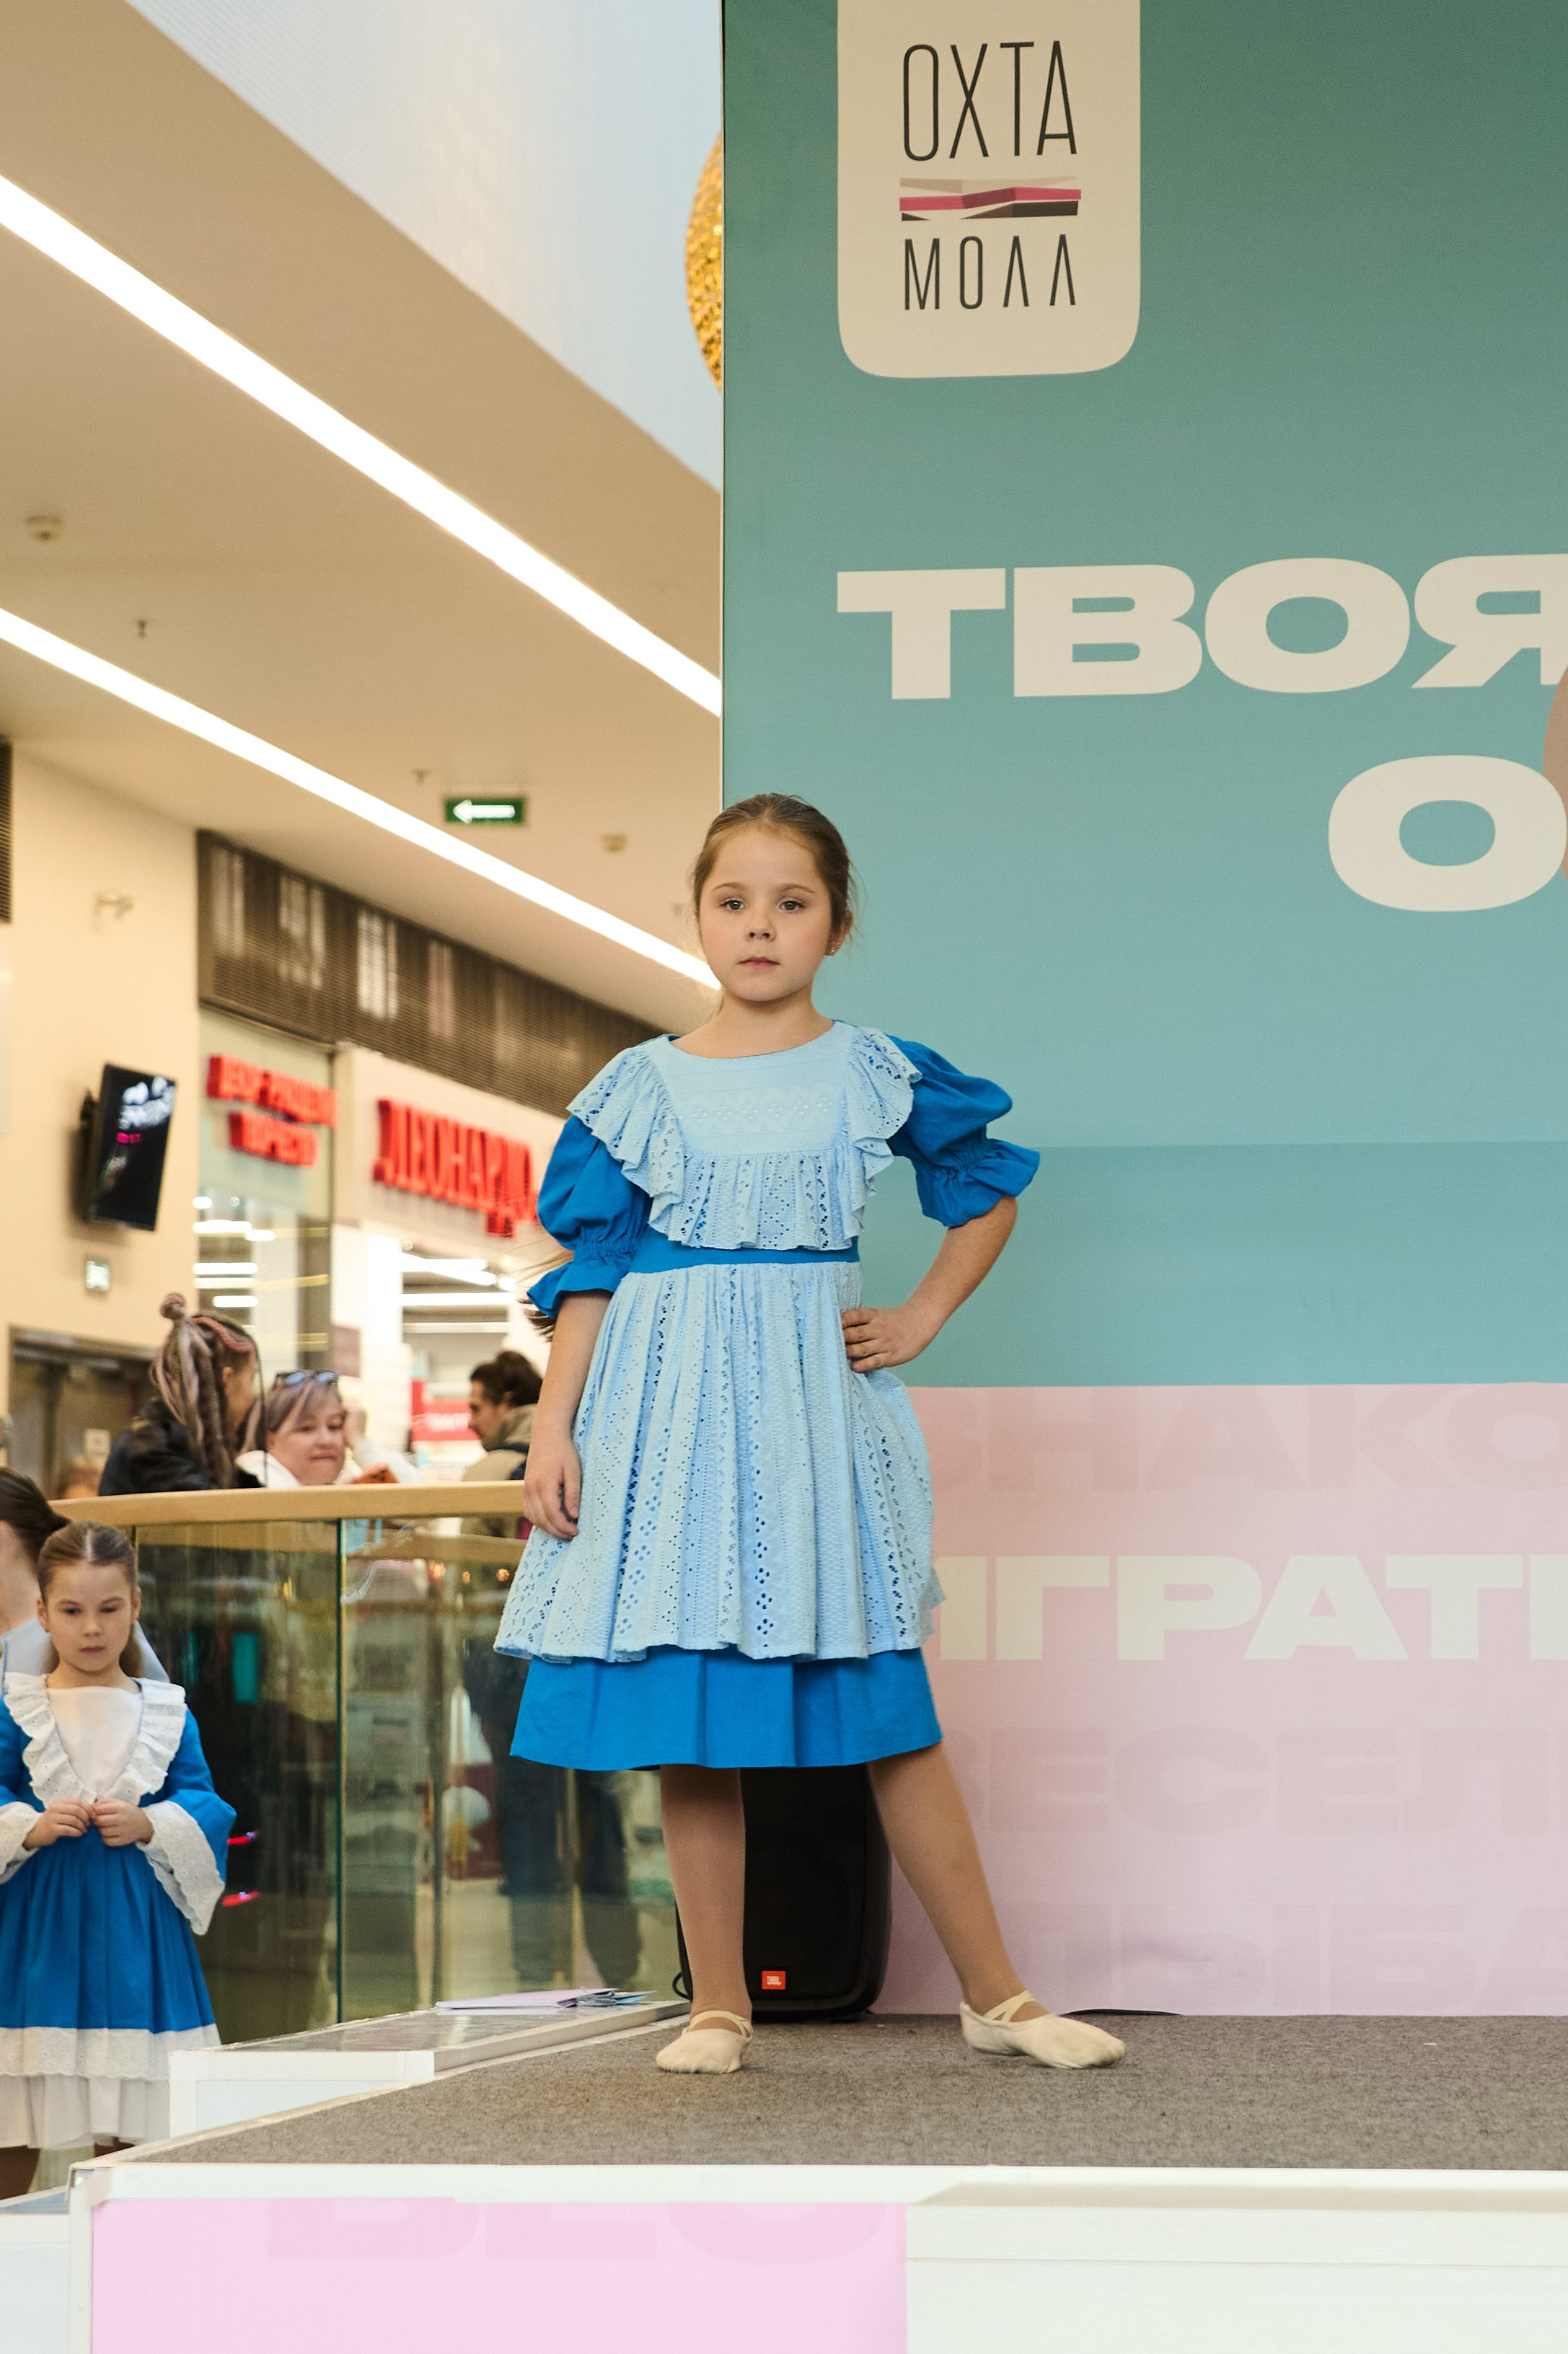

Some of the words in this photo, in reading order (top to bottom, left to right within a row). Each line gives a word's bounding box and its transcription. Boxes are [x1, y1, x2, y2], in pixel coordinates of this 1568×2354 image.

[903, 40, 1077, 161] ОХТА
[904, 234, 1075, 310] МОЛЛ
[837, 553, 1568, 700] ТВОЯ
[1328, 754, 1567, 912] О
